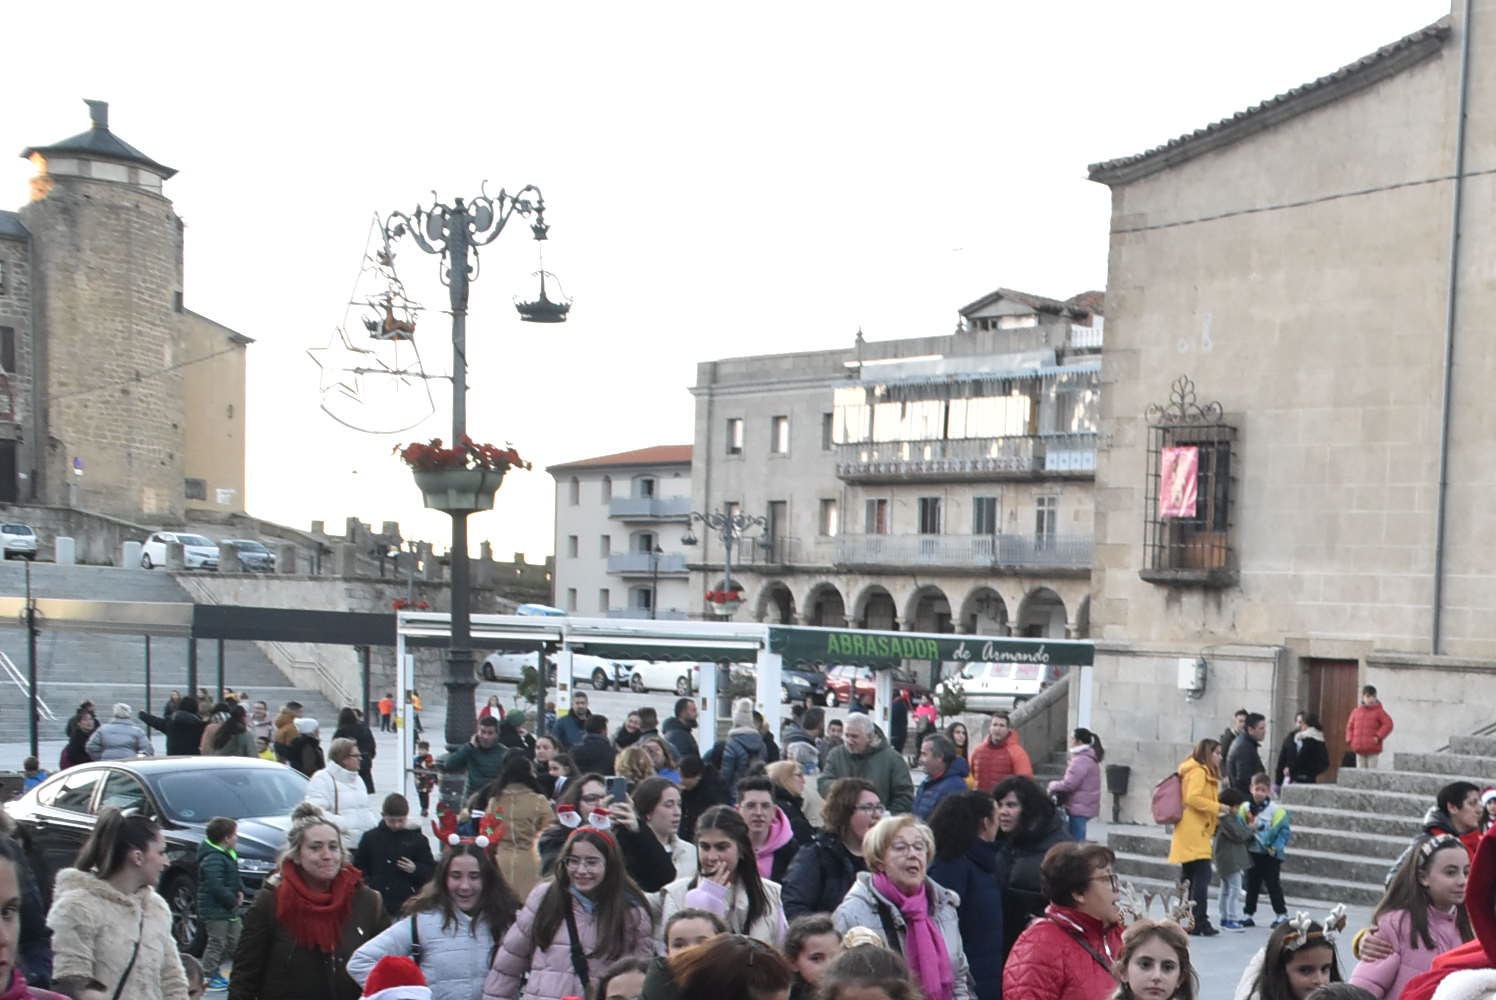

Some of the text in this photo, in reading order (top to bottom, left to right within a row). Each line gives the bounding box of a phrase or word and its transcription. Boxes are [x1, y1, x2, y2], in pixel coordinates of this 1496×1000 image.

[827, 633, 1050, 662] ABRASADOR de Armando
